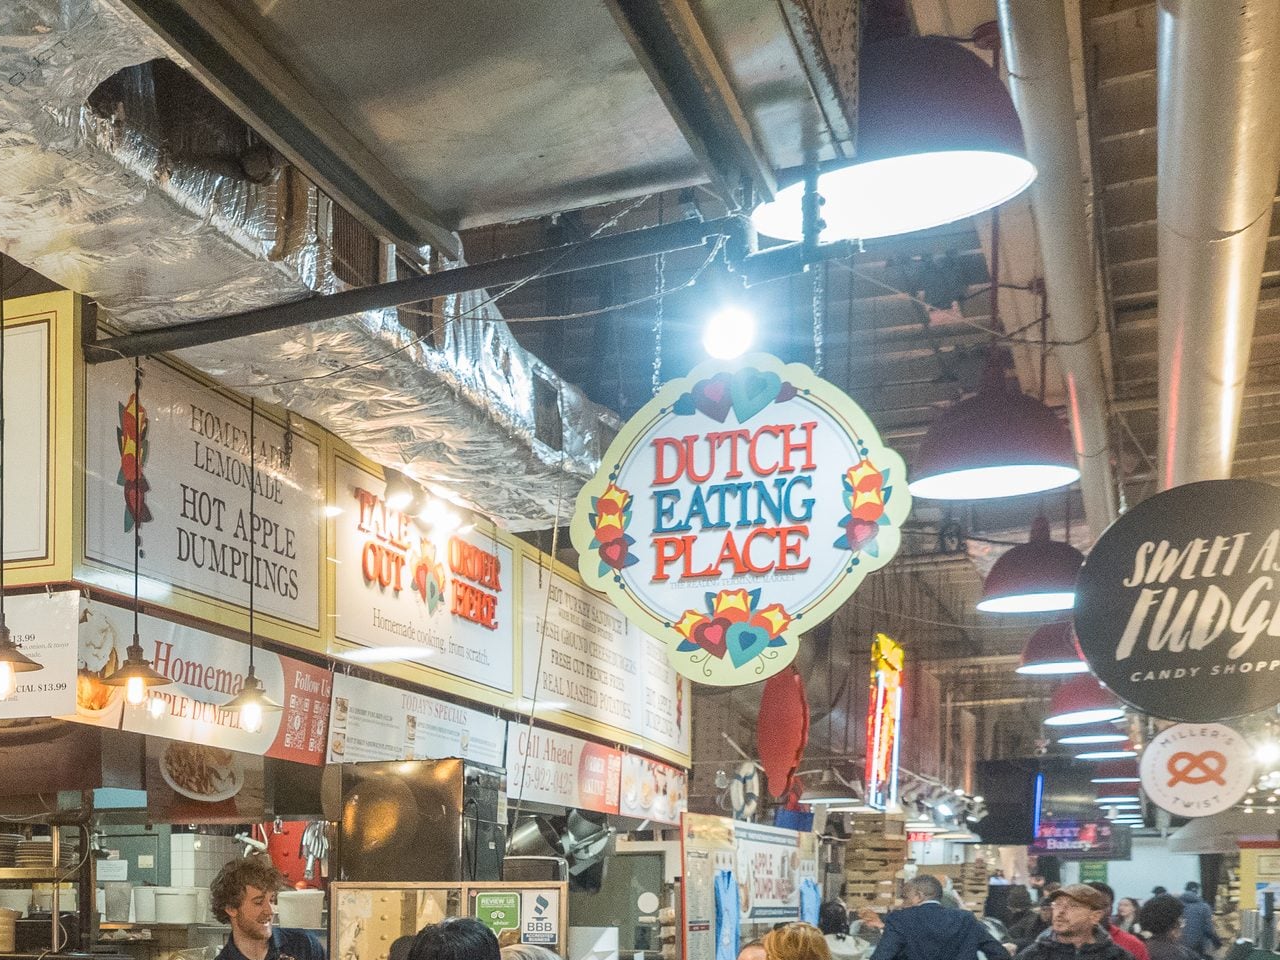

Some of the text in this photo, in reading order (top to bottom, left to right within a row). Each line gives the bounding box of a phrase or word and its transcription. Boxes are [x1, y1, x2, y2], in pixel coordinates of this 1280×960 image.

[194, 441, 283, 505] LEMONADE
[651, 421, 818, 486] DUTCH
[180, 483, 296, 560] HOT APPLE
[651, 475, 816, 534] EATING
[177, 527, 299, 600] DUMPLINGS
[448, 535, 502, 592] ORDER
[651, 525, 811, 581] PLACE
[1123, 529, 1280, 588] SWEET A
[362, 540, 406, 593] OUT
[450, 579, 498, 631] HERE
[372, 607, 416, 642] Homemade
[37, 683, 68, 692] $13.99
[295, 671, 331, 698] Follow Us
[1130, 666, 1201, 682] CANDY
[518, 731, 540, 759] Call
[543, 736, 573, 767] Ahead
[1172, 794, 1219, 808] TWIST
[527, 922, 552, 932] BBB
